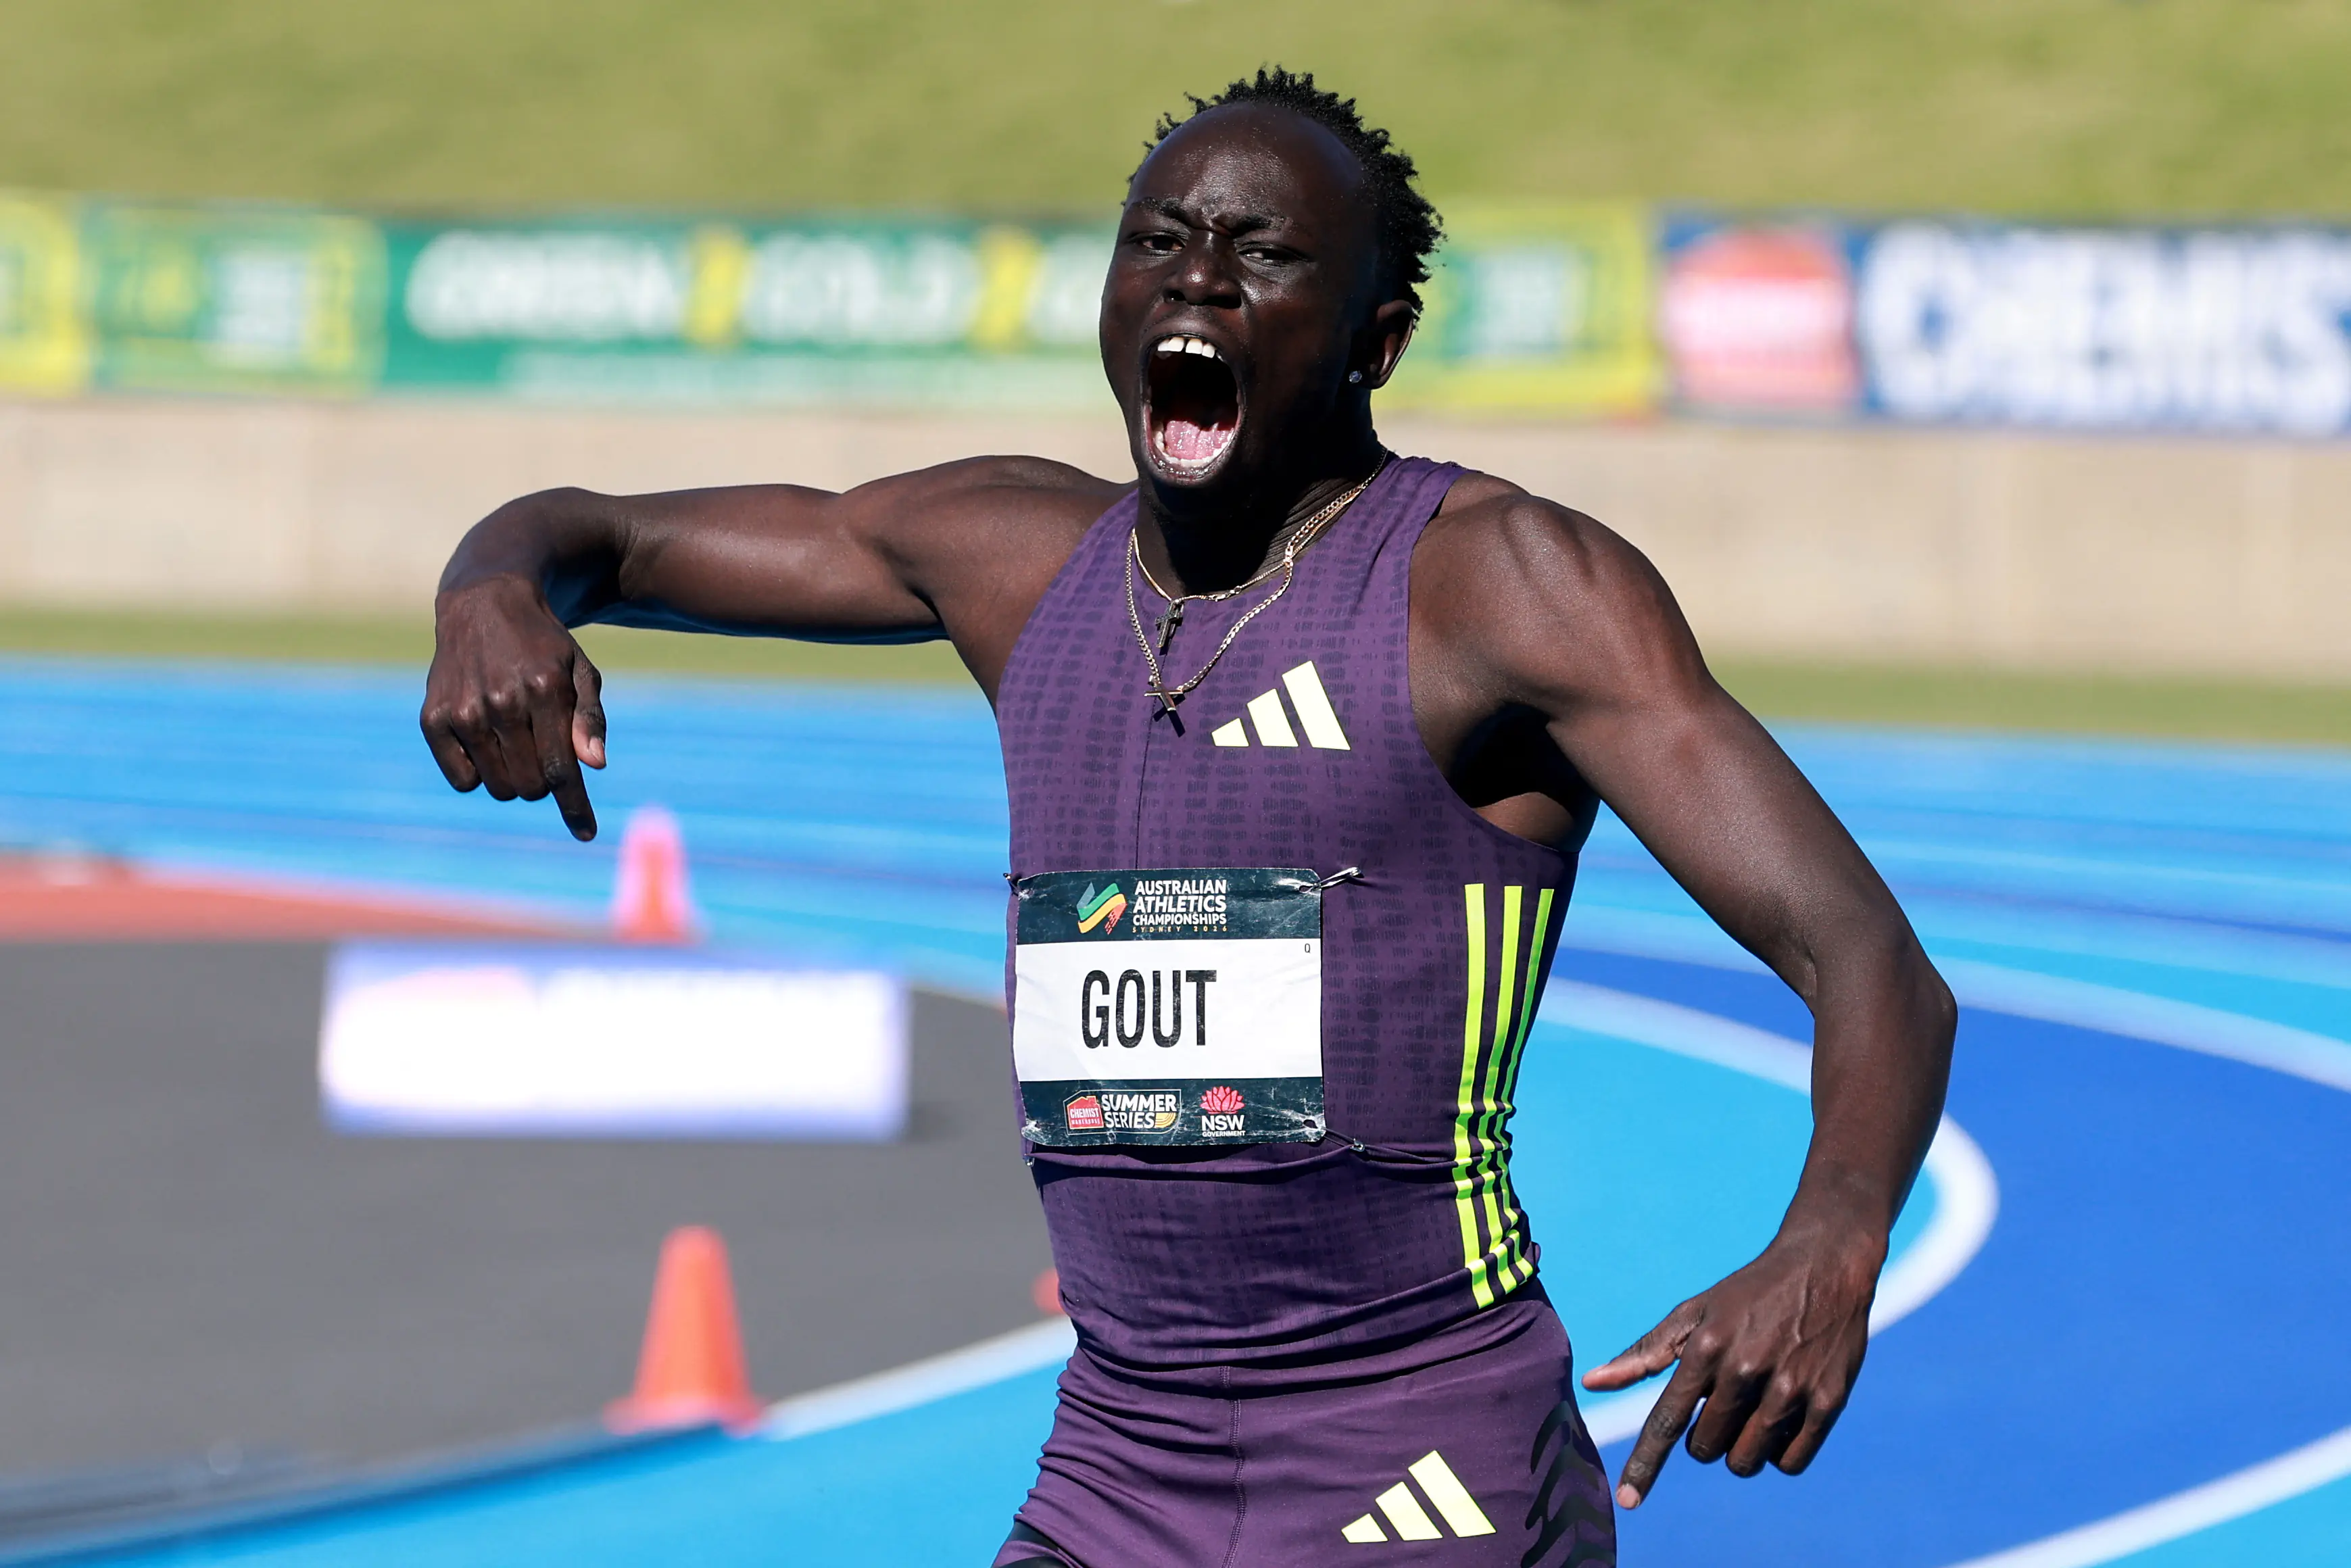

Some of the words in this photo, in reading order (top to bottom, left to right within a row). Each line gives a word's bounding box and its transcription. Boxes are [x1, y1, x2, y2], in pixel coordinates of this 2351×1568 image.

[1134, 879, 1227, 896] AUSTRALIAN
[1133, 895, 1227, 913] ATHLETICS
[1132, 913, 1227, 926] CHAMPIONSHIPS
[1305, 944, 1311, 953] Q
[1082, 969, 1217, 1049] GOUT
[1101, 1094, 1177, 1112] SUMMER
[1070, 1107, 1099, 1118] CHEMIST
[1104, 1112, 1155, 1129] SERIES
[1201, 1114, 1244, 1131] NSW
